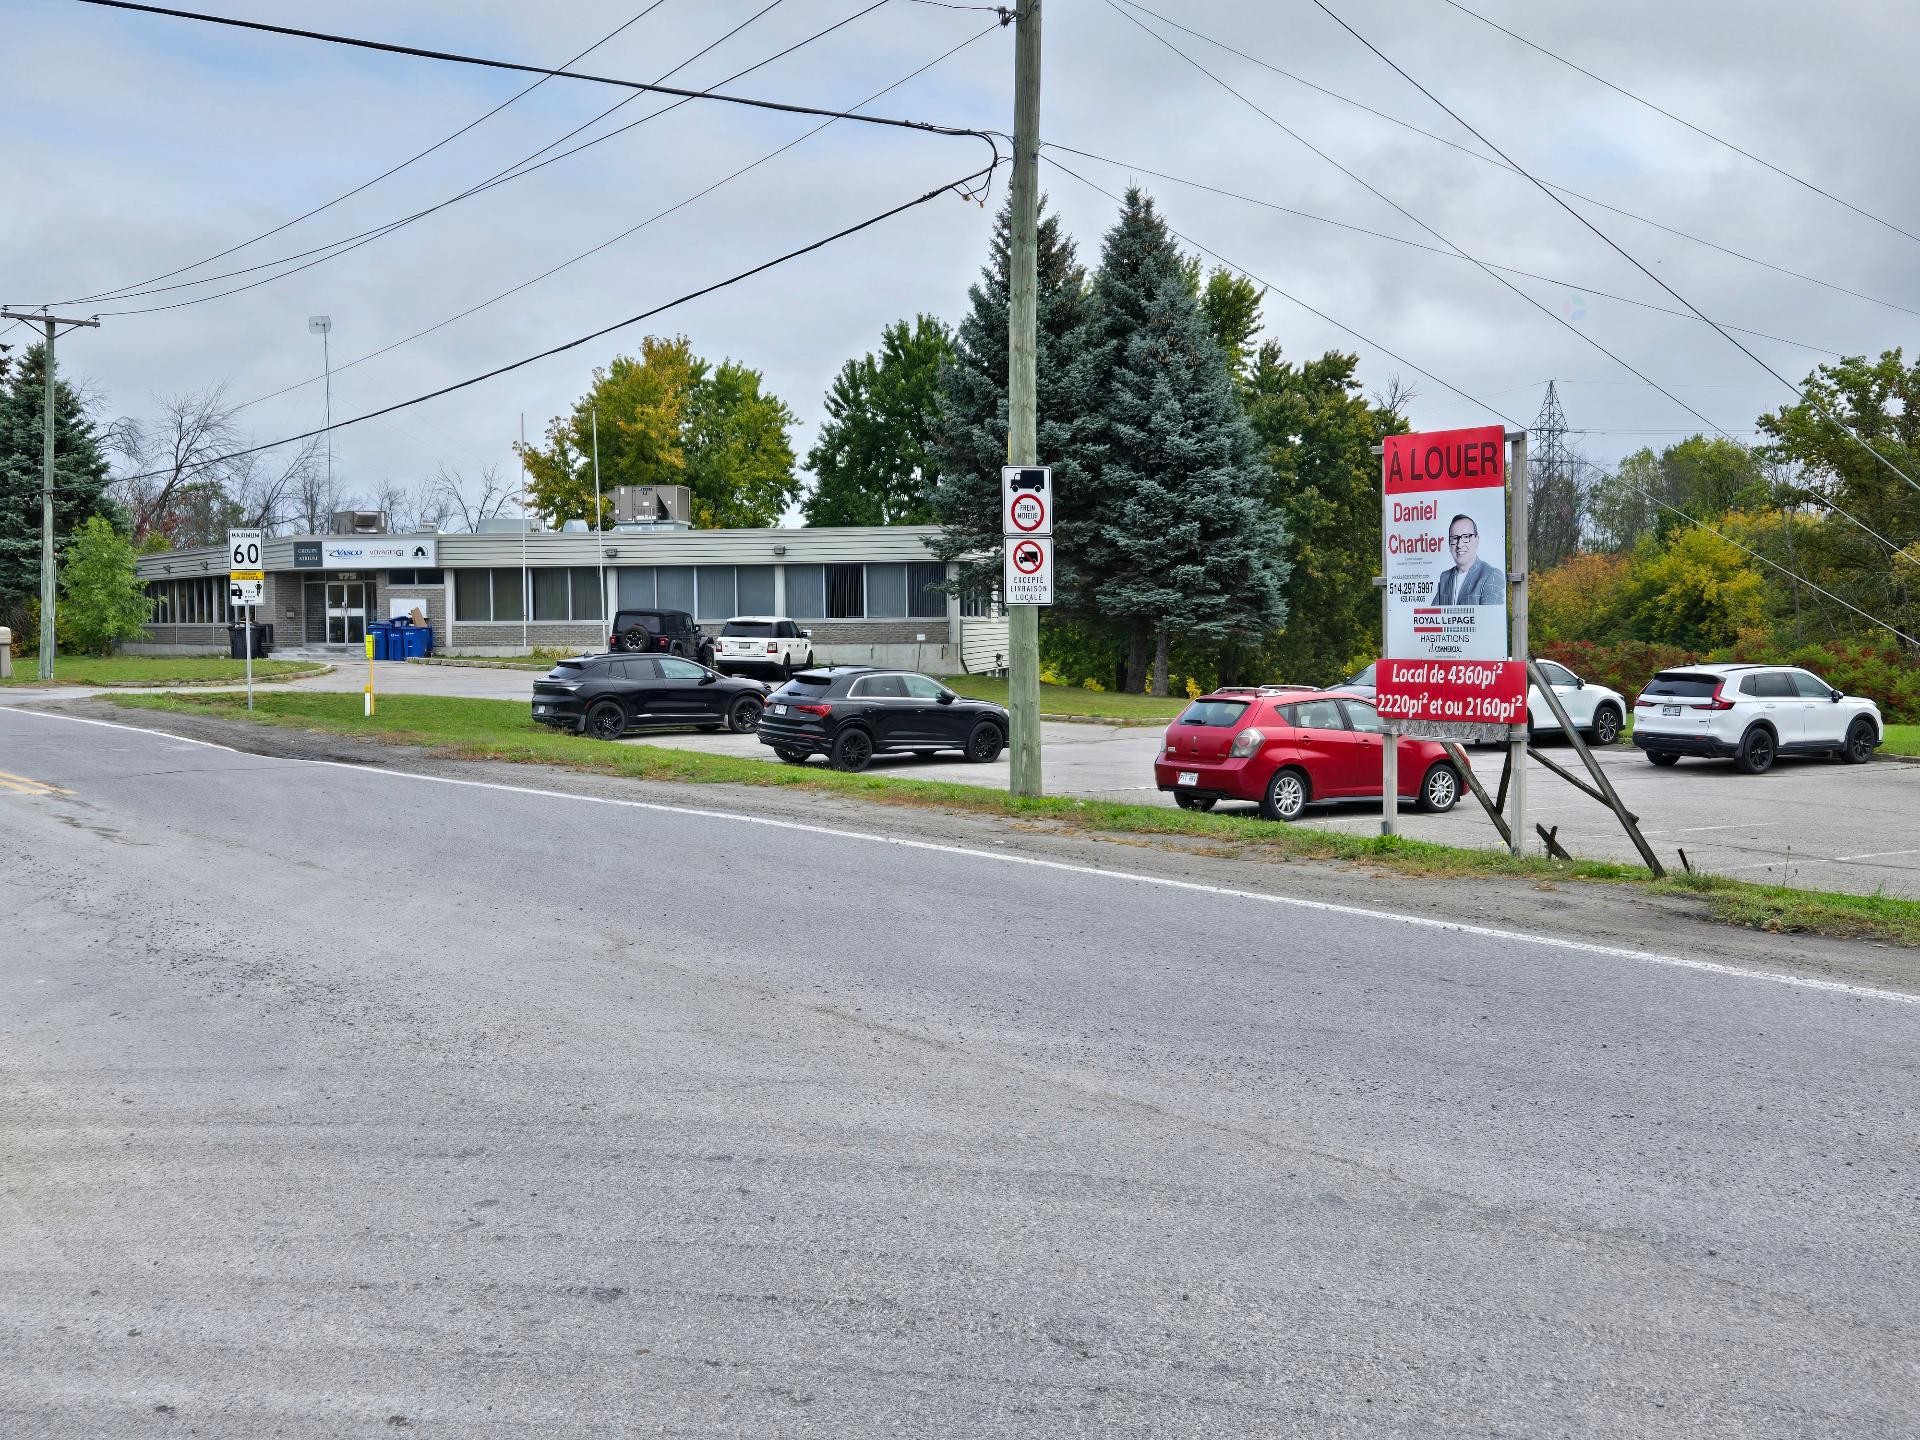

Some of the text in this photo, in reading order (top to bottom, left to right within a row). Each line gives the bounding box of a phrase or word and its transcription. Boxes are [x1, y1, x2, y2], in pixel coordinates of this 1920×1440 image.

[1388, 441, 1499, 483] À LOUER
[1019, 504, 1036, 512] FREIN
[1393, 500, 1438, 523] Daniel
[1017, 512, 1038, 520] MOTEUR
[1388, 533, 1445, 555] Chartier
[233, 543, 259, 564] 60
[1013, 574, 1044, 584] EXCEPTÉ
[1015, 593, 1042, 601] LOCALE
[1413, 616, 1441, 625] ROYAL
[1420, 634, 1470, 643] HABITATIONS
[1392, 663, 1428, 683] Local
[1429, 663, 1445, 684] de
[1429, 697, 1443, 715] et
[1444, 699, 1463, 716] ou
